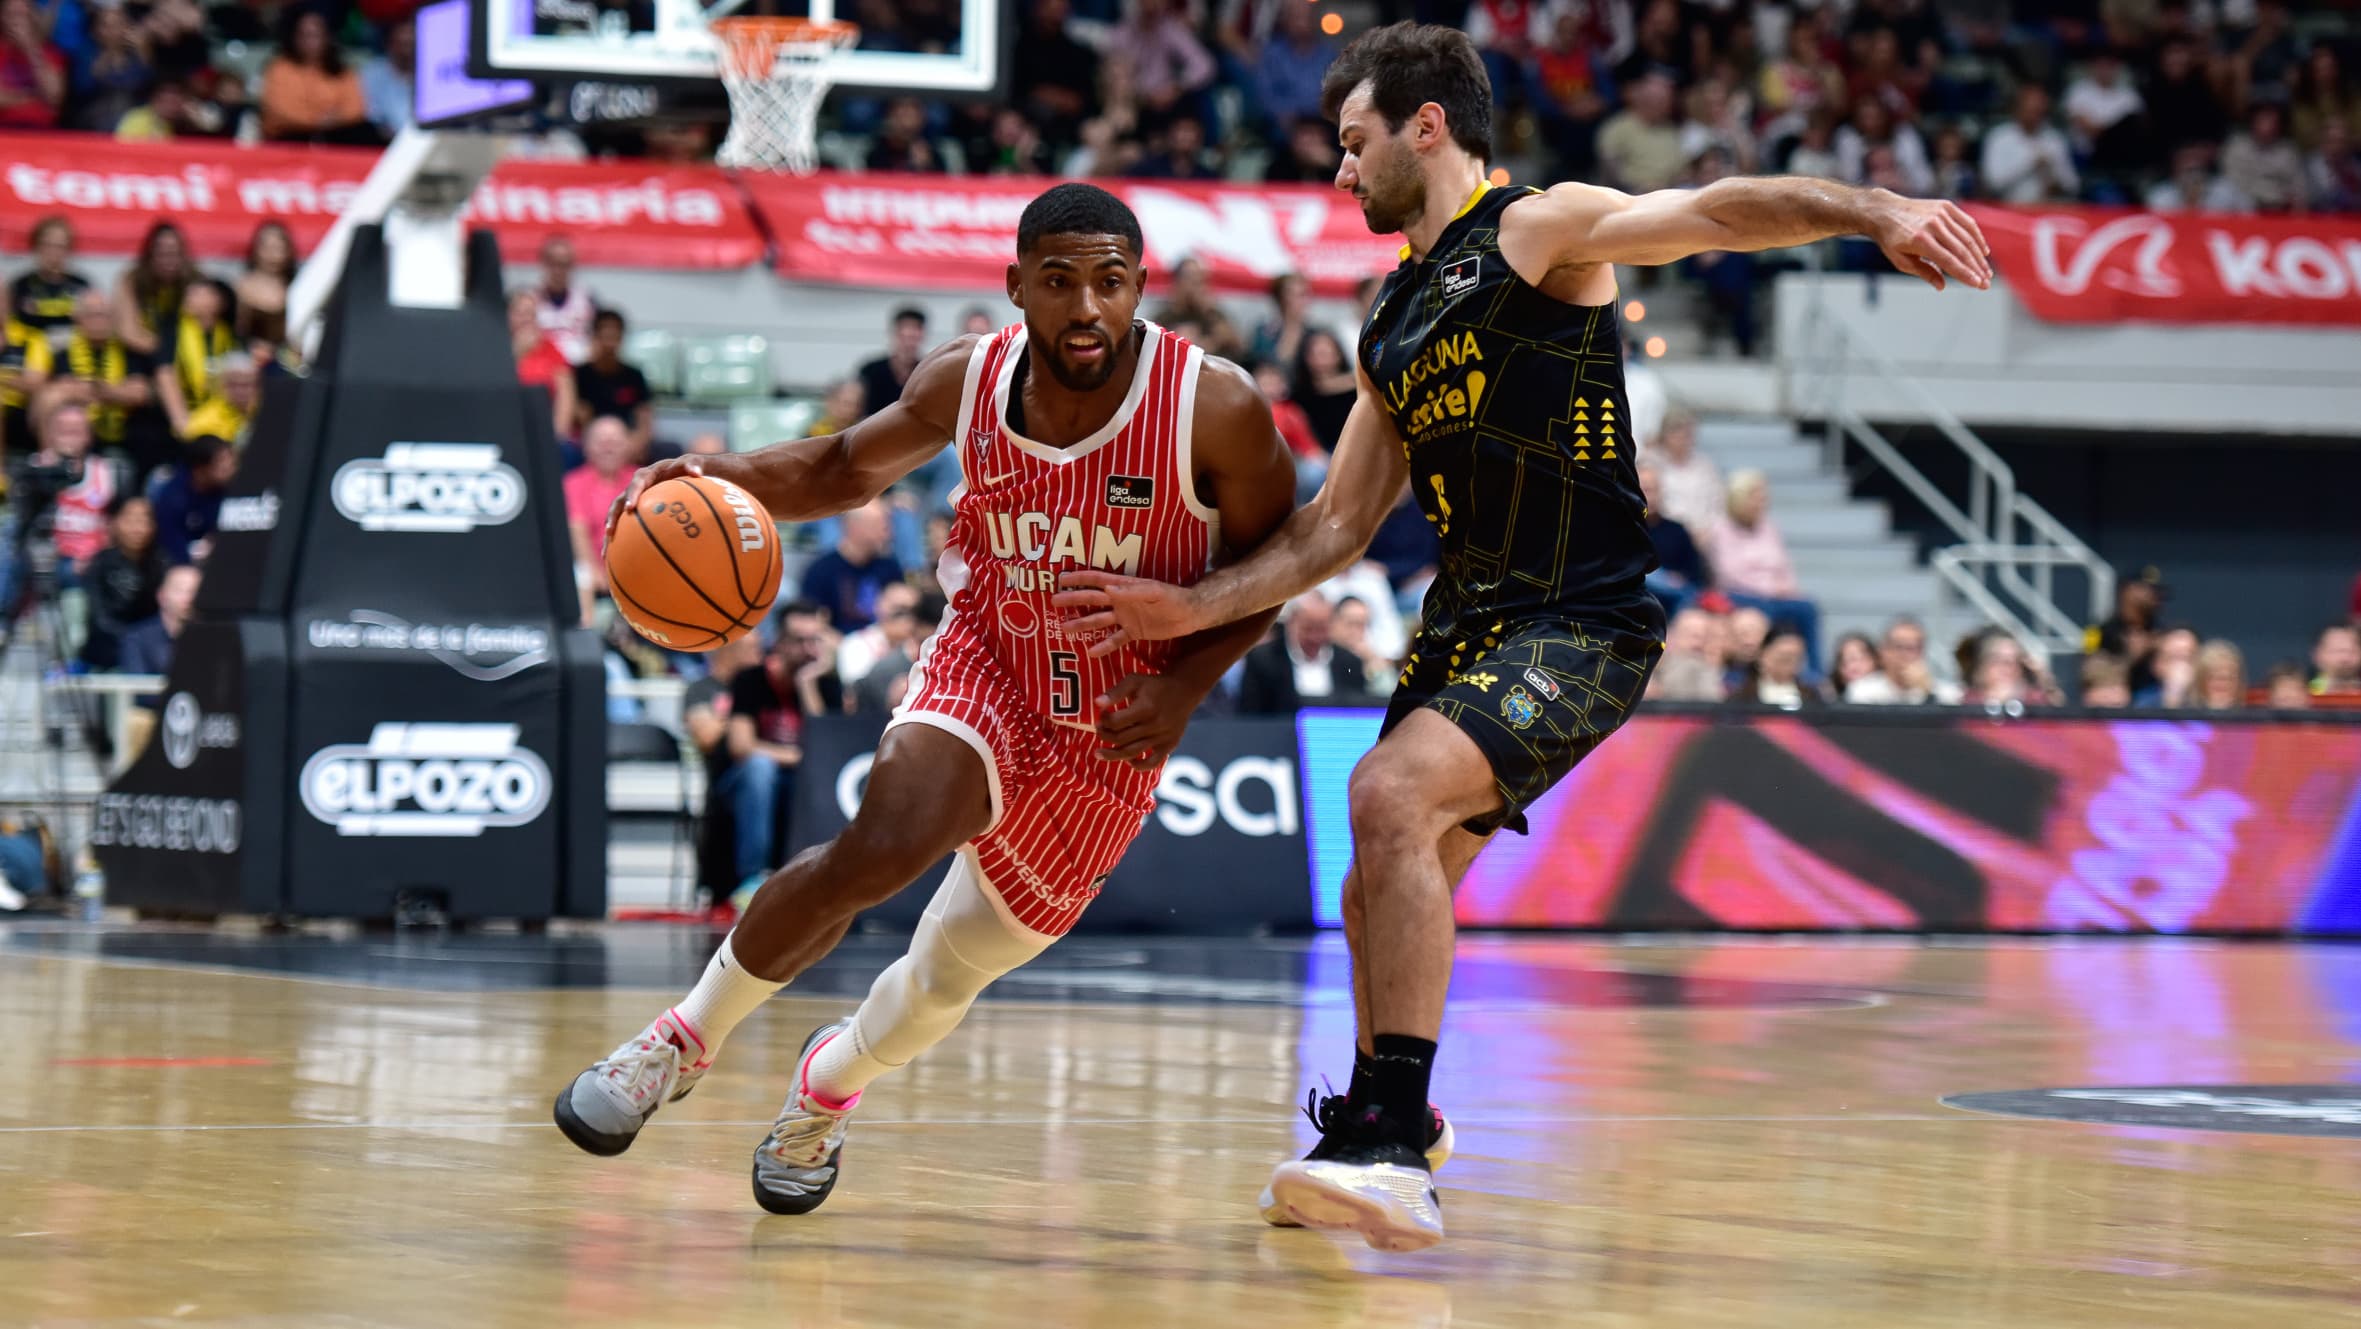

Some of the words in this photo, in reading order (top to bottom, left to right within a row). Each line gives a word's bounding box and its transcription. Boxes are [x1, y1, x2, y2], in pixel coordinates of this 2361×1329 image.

[238, 176, 725, 226] mainaria
[1110, 484, 1129, 495] liga
[1110, 496, 1150, 505] endesa
[669, 501, 701, 538] acb
[986, 511, 1143, 577] UCAM
[1047, 629, 1063, 640] DE
[1050, 651, 1081, 716] 5
[1528, 673, 1550, 692] acb
